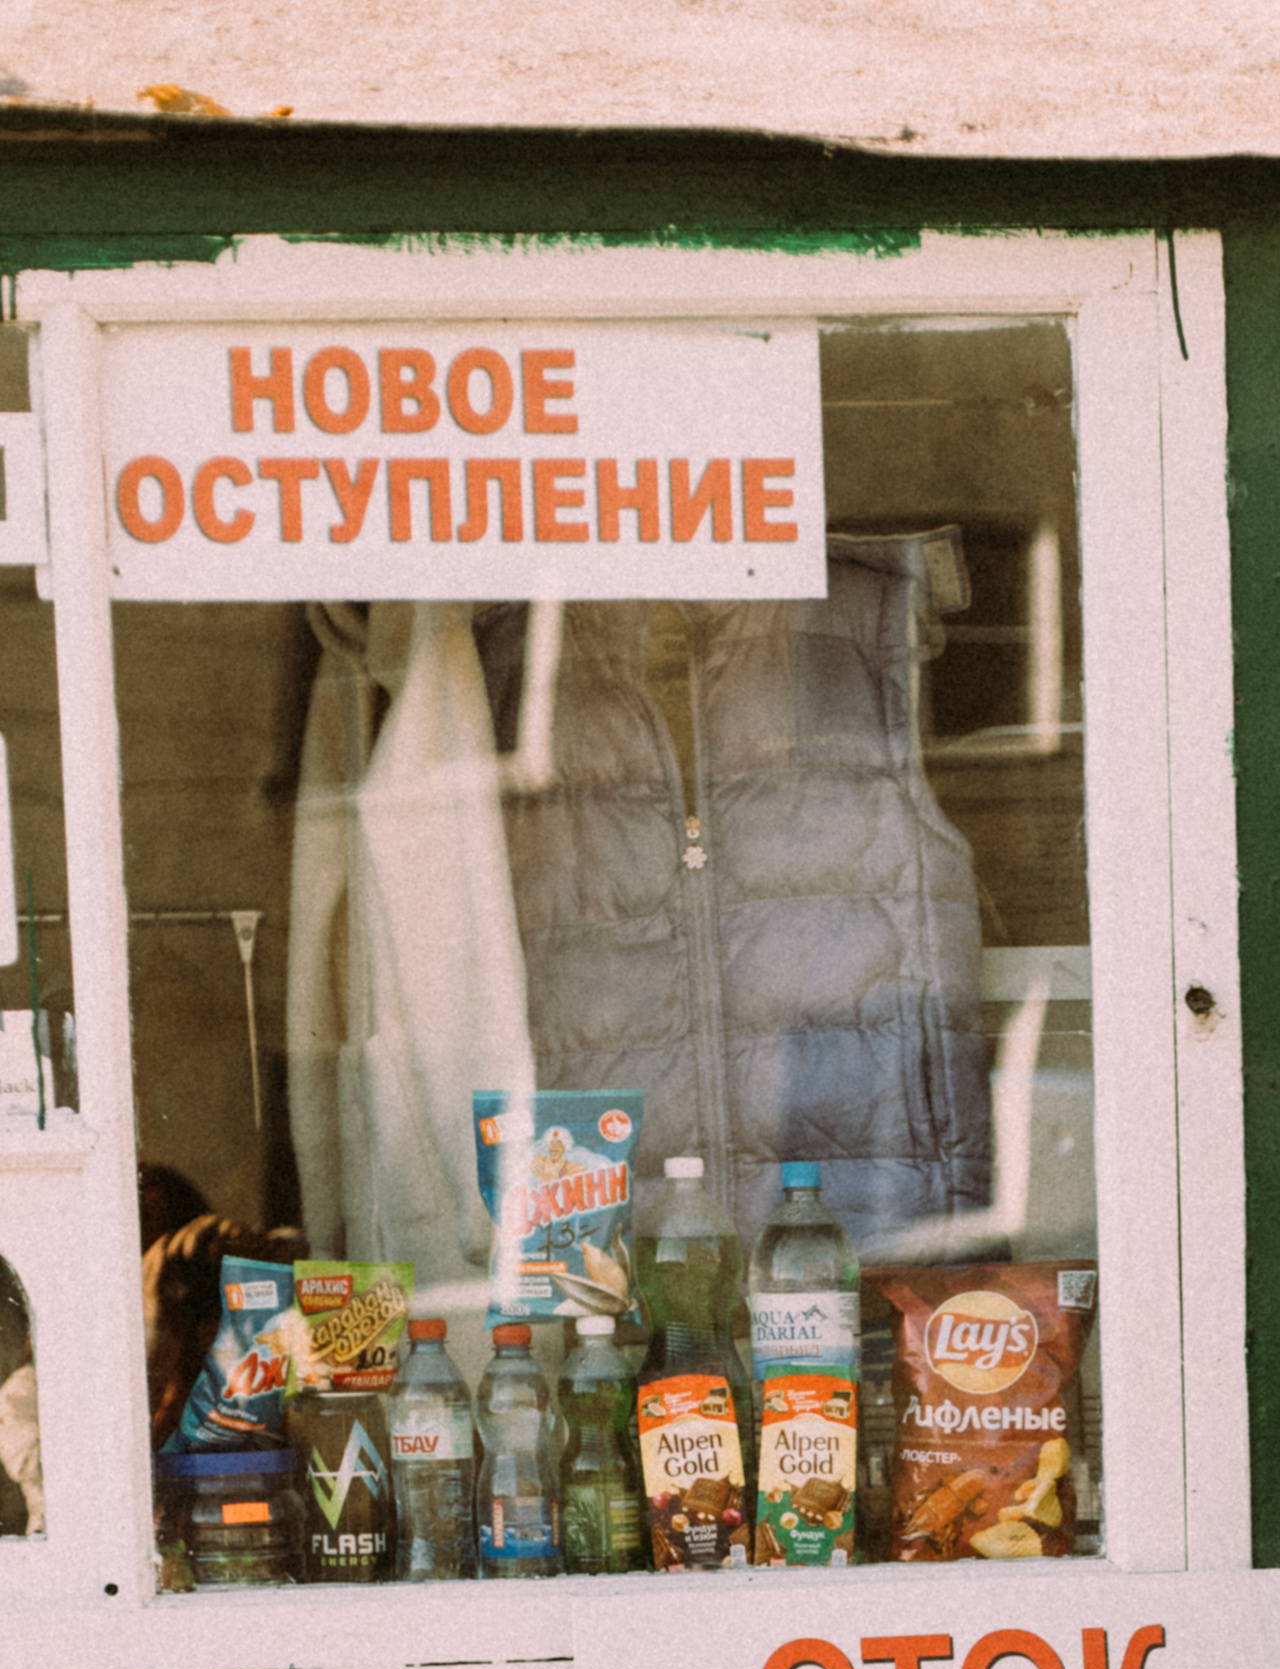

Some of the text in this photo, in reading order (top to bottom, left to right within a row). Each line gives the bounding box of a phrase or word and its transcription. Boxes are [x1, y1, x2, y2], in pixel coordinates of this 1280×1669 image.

[229, 346, 579, 434] НОВОЕ
[103, 455, 800, 544] ОСТУПЛЕНИЕ
[302, 1280, 348, 1295] АРАХИС
[757, 1326, 822, 1341] DARIAL
[933, 1314, 1030, 1370] Lay's
[902, 1396, 1066, 1434] Рифленые
[657, 1432, 723, 1458] Alpen
[775, 1429, 839, 1457] Alpen
[664, 1451, 719, 1477] Gold
[779, 1453, 834, 1474] Gold
[312, 1533, 387, 1555] FLASH
[321, 1557, 377, 1567] ENERGY
